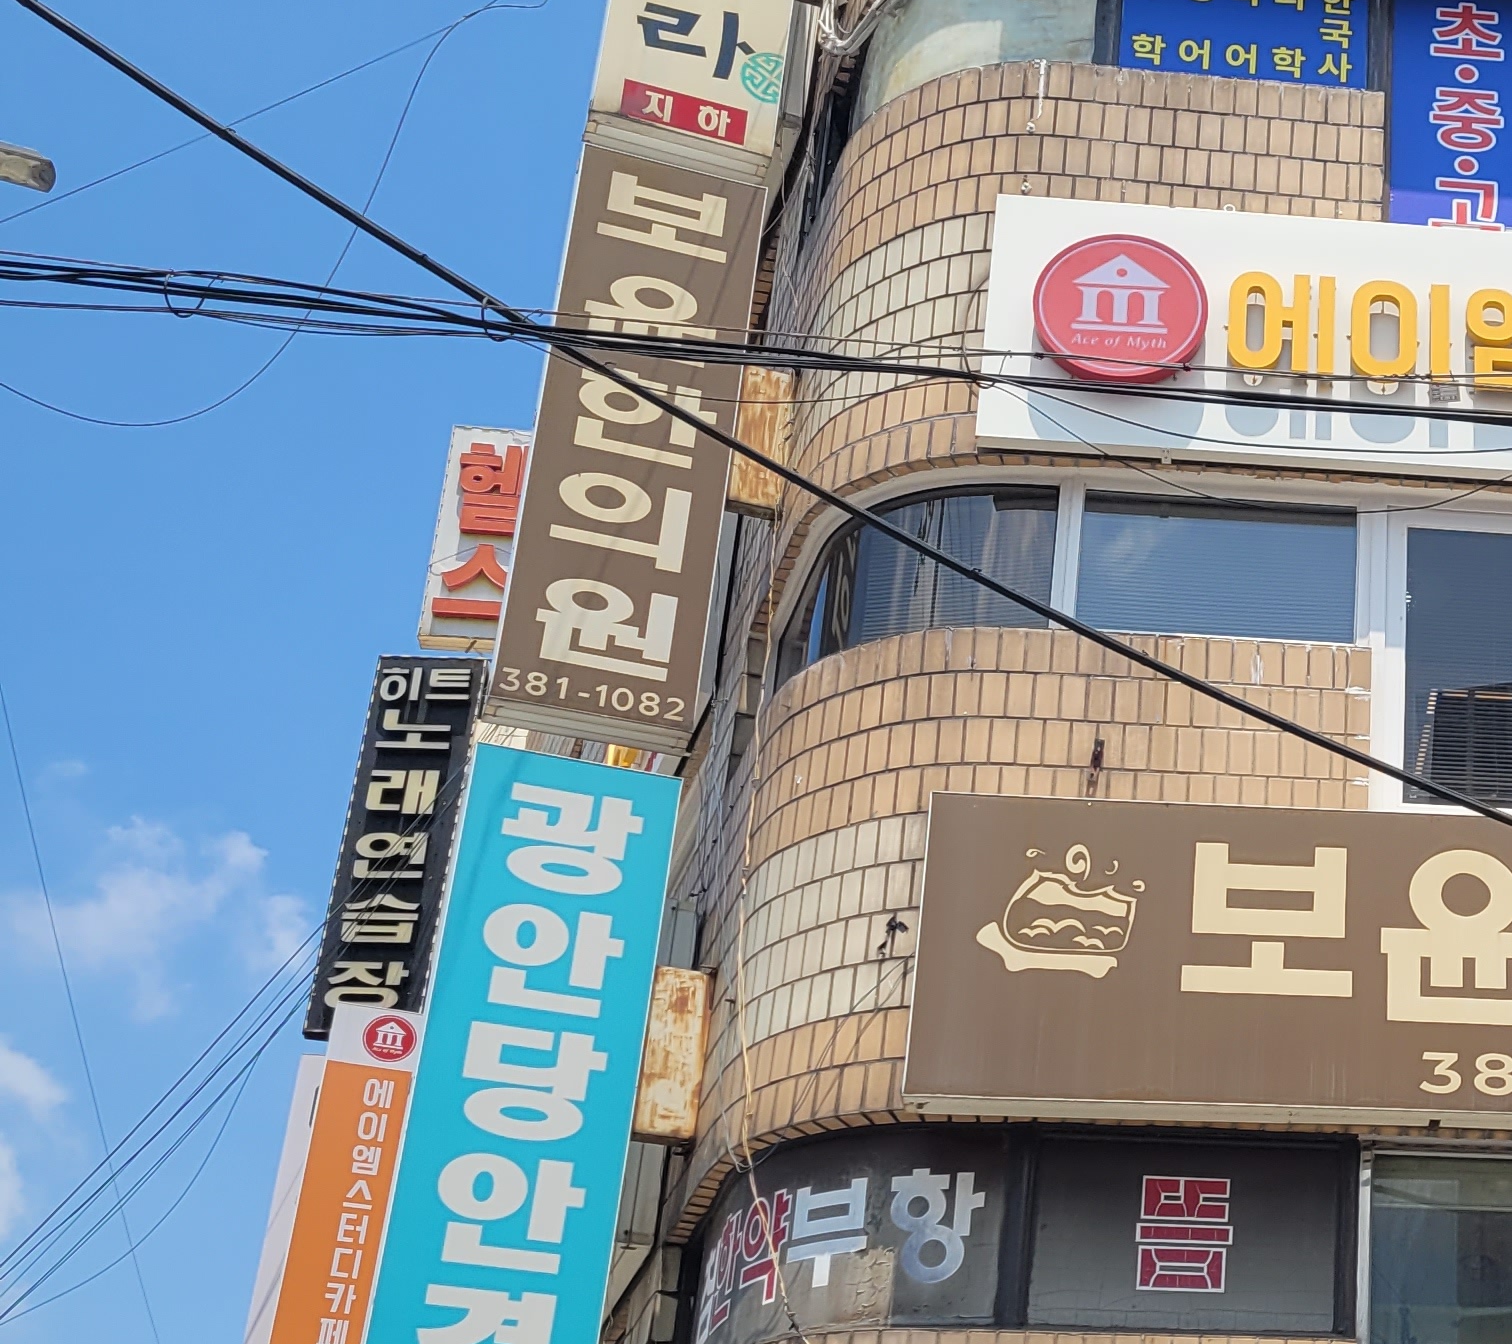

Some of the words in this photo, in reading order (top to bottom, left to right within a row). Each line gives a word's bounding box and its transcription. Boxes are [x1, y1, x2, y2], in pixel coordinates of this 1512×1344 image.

[642, 89, 731, 139] 지하
[1072, 333, 1098, 345] Ace
[1105, 335, 1119, 348] of
[1127, 336, 1168, 350] Myth
[536, 170, 729, 682] 보윤한의원
[498, 666, 686, 723] 381-1082
[324, 710, 450, 1011] 노래연습장
[1135, 1174, 1234, 1293] 뜸
